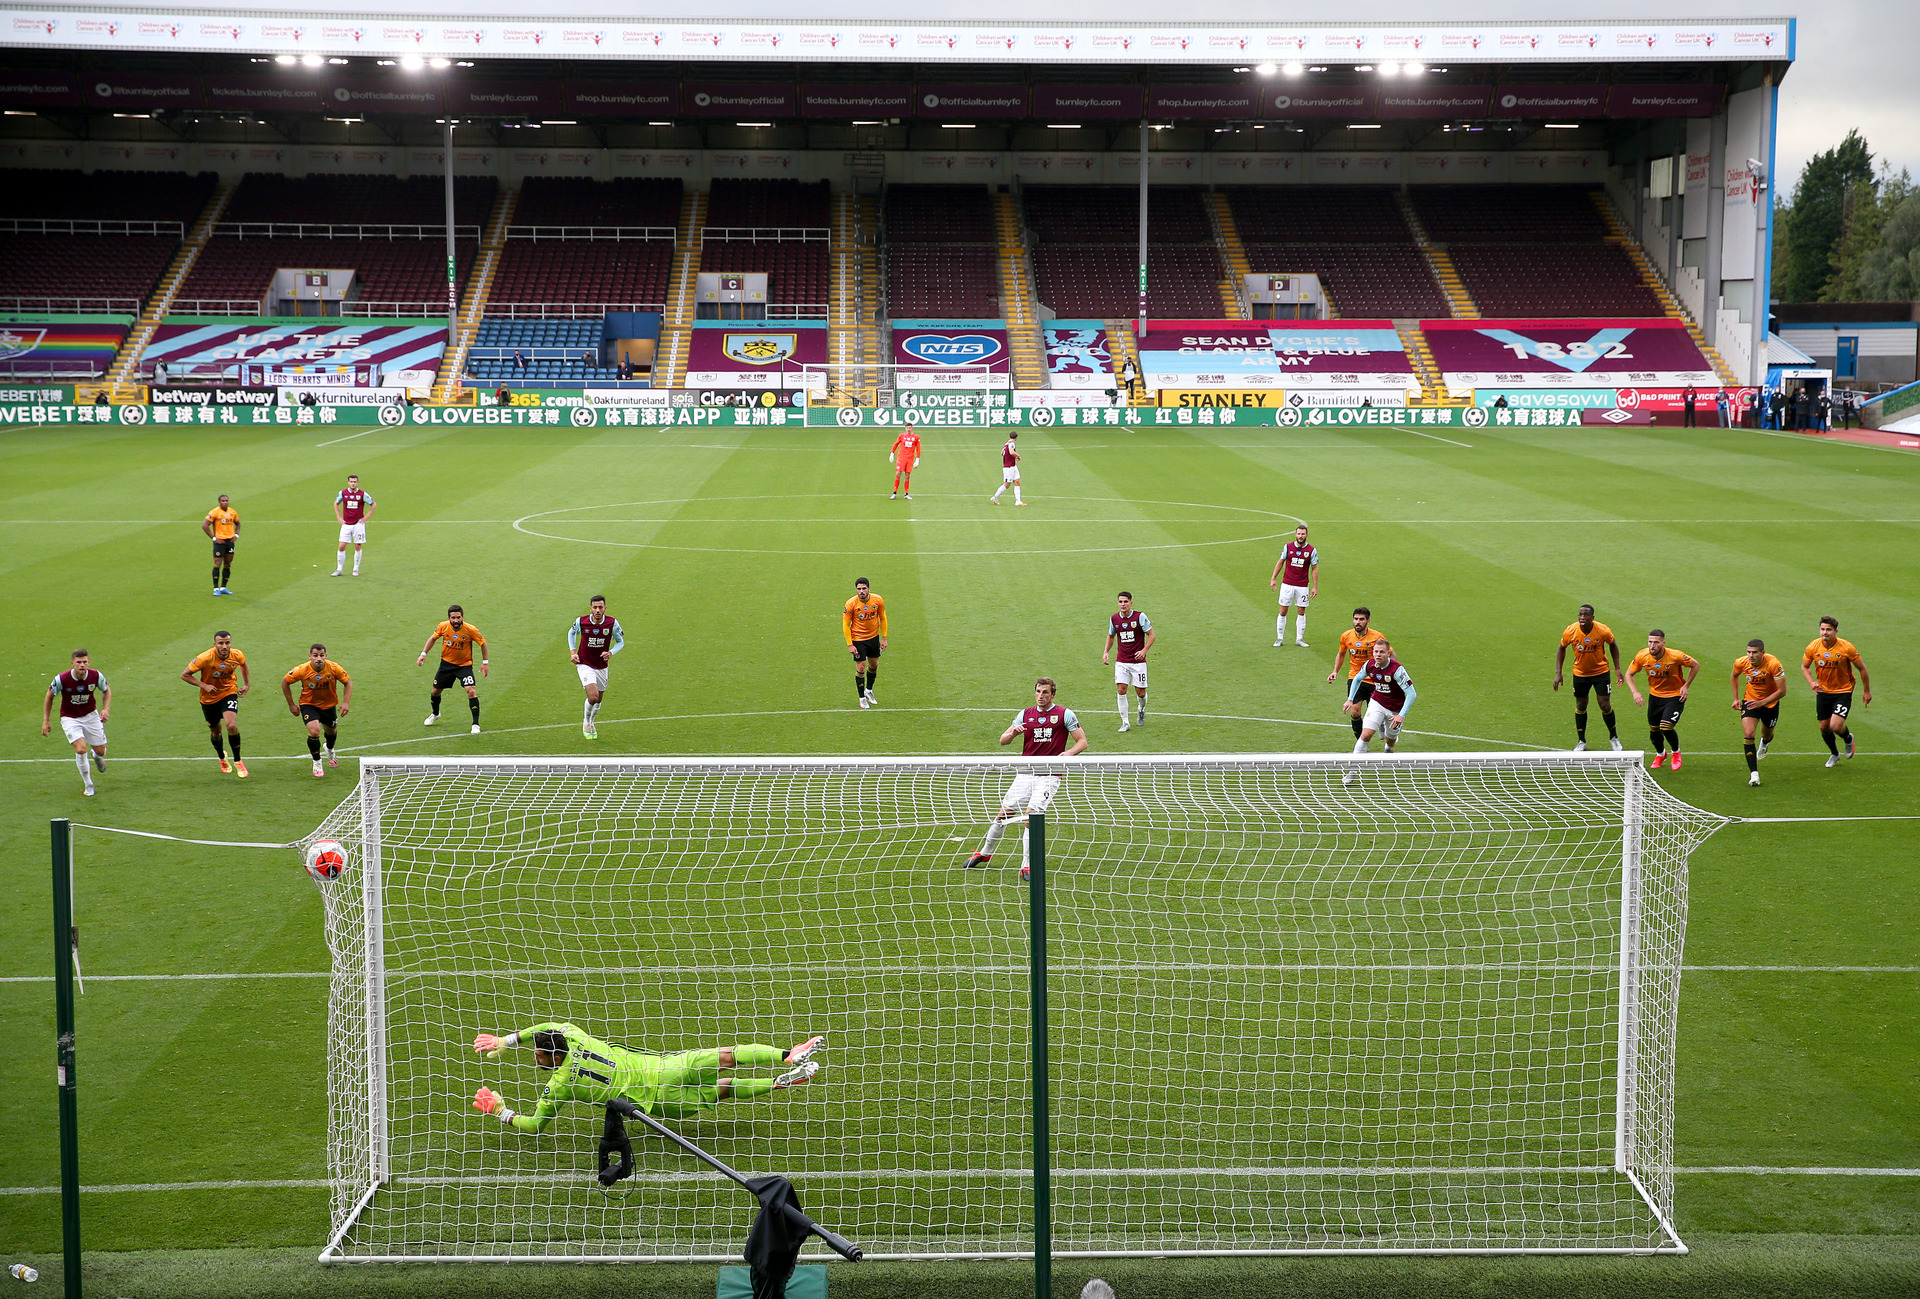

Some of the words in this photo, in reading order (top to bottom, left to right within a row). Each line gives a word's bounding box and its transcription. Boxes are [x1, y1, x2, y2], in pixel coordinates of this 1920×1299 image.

[471, 94, 538, 102] burnleyfc.com
[577, 95, 669, 104] shop.burnleyfc.com
[712, 95, 784, 105] @burnleyofficial
[807, 96, 907, 106] tickets.burnleyfc.com
[940, 97, 1021, 107] @officialburnleyfc
[1056, 97, 1121, 107] burnleyfc.com
[1158, 98, 1249, 108] shop.burnleyfc.com
[1293, 98, 1365, 108] @burnleyofficial
[1384, 97, 1483, 107] tickets.burnleyfc.com
[1517, 97, 1598, 107] @officialburnleyfc
[1632, 97, 1698, 106] burnleyfc.com
[312, 276, 320, 285] B
[728, 280, 737, 289] C
[1275, 281, 1284, 290] D
[236, 334, 288, 346] UP
[293, 334, 362, 346] THE
[1181, 336, 1250, 346] SEAN
[1256, 336, 1360, 346] DYCHE'S
[212, 348, 372, 360] CLARETS
[923, 344, 981, 354] NHS
[1053, 347, 1104, 356] UTC
[1178, 346, 1275, 356] CLARET
[1281, 347, 1301, 356] &
[1306, 347, 1371, 356] BLUE
[1503, 342, 1634, 360] 1882
[1240, 357, 1314, 366] ARMY
[268, 373, 288, 384] LEGS
[292, 372, 321, 385] HEARTS
[326, 373, 351, 384] MINDS
[153, 389, 212, 406] betway
[217, 390, 275, 406] betway
[480, 393, 583, 407] be365.com
[594, 395, 665, 405] Oakfurnitureland
[672, 392, 694, 403] sofa
[1179, 393, 1267, 407] STANLEY
[1307, 395, 1360, 406] Barnfield
[1508, 394, 1608, 406] savesavvi
[1618, 393, 1636, 408] bd
[153, 407, 239, 424] 看球有礼
[252, 407, 337, 424] 红包给你
[431, 407, 560, 425] LOVEBET爱博
[604, 408, 721, 426] 体育滚球APP
[892, 408, 1022, 425] LOVEBET爱博
[1060, 408, 1142, 425] 看球有礼
[1155, 408, 1237, 425] 红包给你
[1326, 408, 1453, 425] LOVEBET爱博
[462, 675, 475, 686] 28
[1138, 673, 1146, 683] 18
[1834, 703, 1848, 717] 32
[1670, 711, 1680, 722] 2
[1033, 727, 1053, 739] 爱博
[1043, 790, 1050, 801] 9
[577, 1049, 617, 1086] 11
